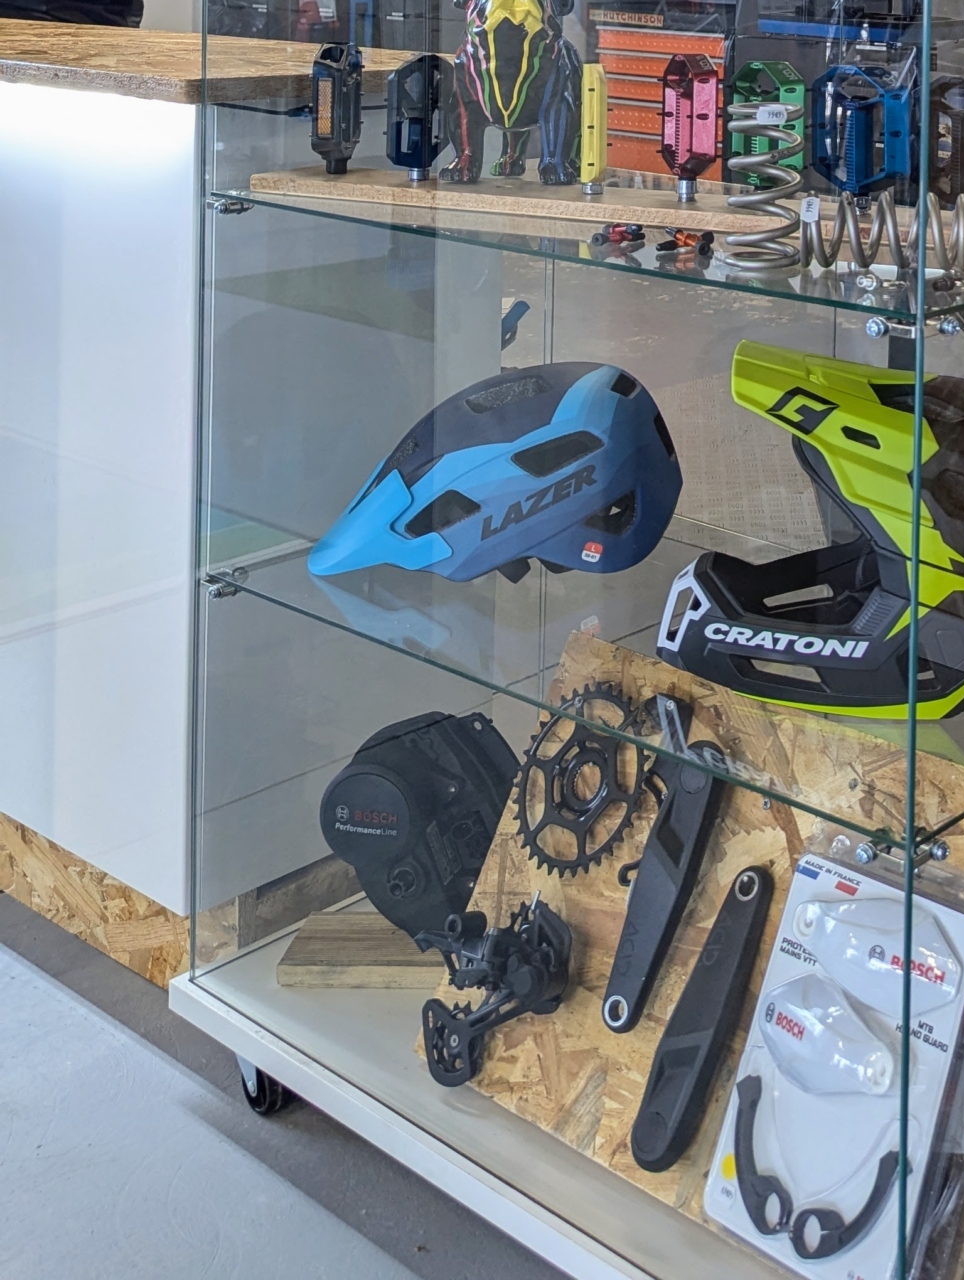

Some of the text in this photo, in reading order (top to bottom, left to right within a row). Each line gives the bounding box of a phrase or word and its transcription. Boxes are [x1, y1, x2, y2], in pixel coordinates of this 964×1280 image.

[602, 10, 663, 25] HUTCHINSON
[480, 463, 598, 542] LAZER
[703, 622, 869, 659] CRATONI
[354, 809, 398, 824] BOSCH
[804, 859, 862, 887] MADE IN FRANCE
[780, 945, 818, 966] MAINS VTT
[775, 1011, 806, 1040] BOSCH
[895, 1023, 922, 1040] HND
[922, 1033, 949, 1052] GUARD
[918, 1019, 934, 1034] MTB
